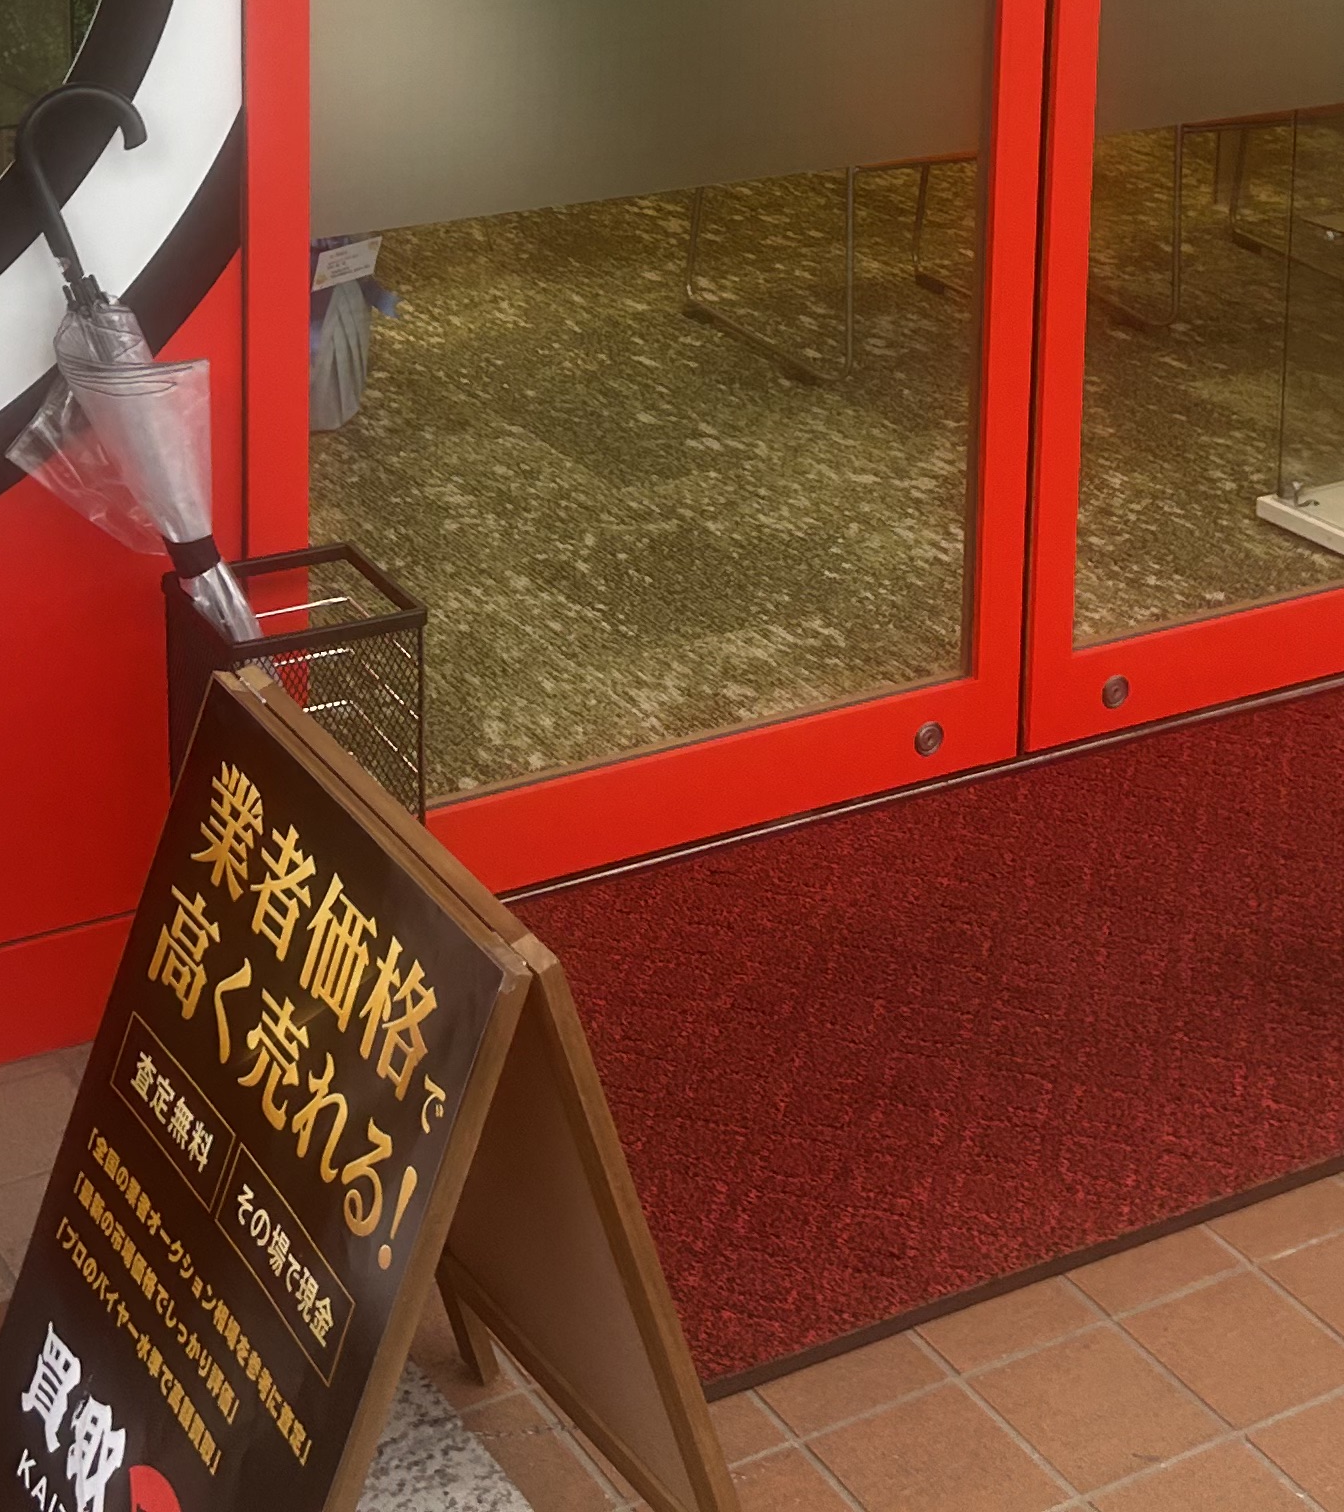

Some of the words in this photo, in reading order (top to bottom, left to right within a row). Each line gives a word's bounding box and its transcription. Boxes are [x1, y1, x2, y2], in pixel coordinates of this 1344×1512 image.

[191, 761, 446, 1133] 業者価格で
[130, 1051, 214, 1174] 査定無料
[236, 1183, 334, 1348] その場で現金
